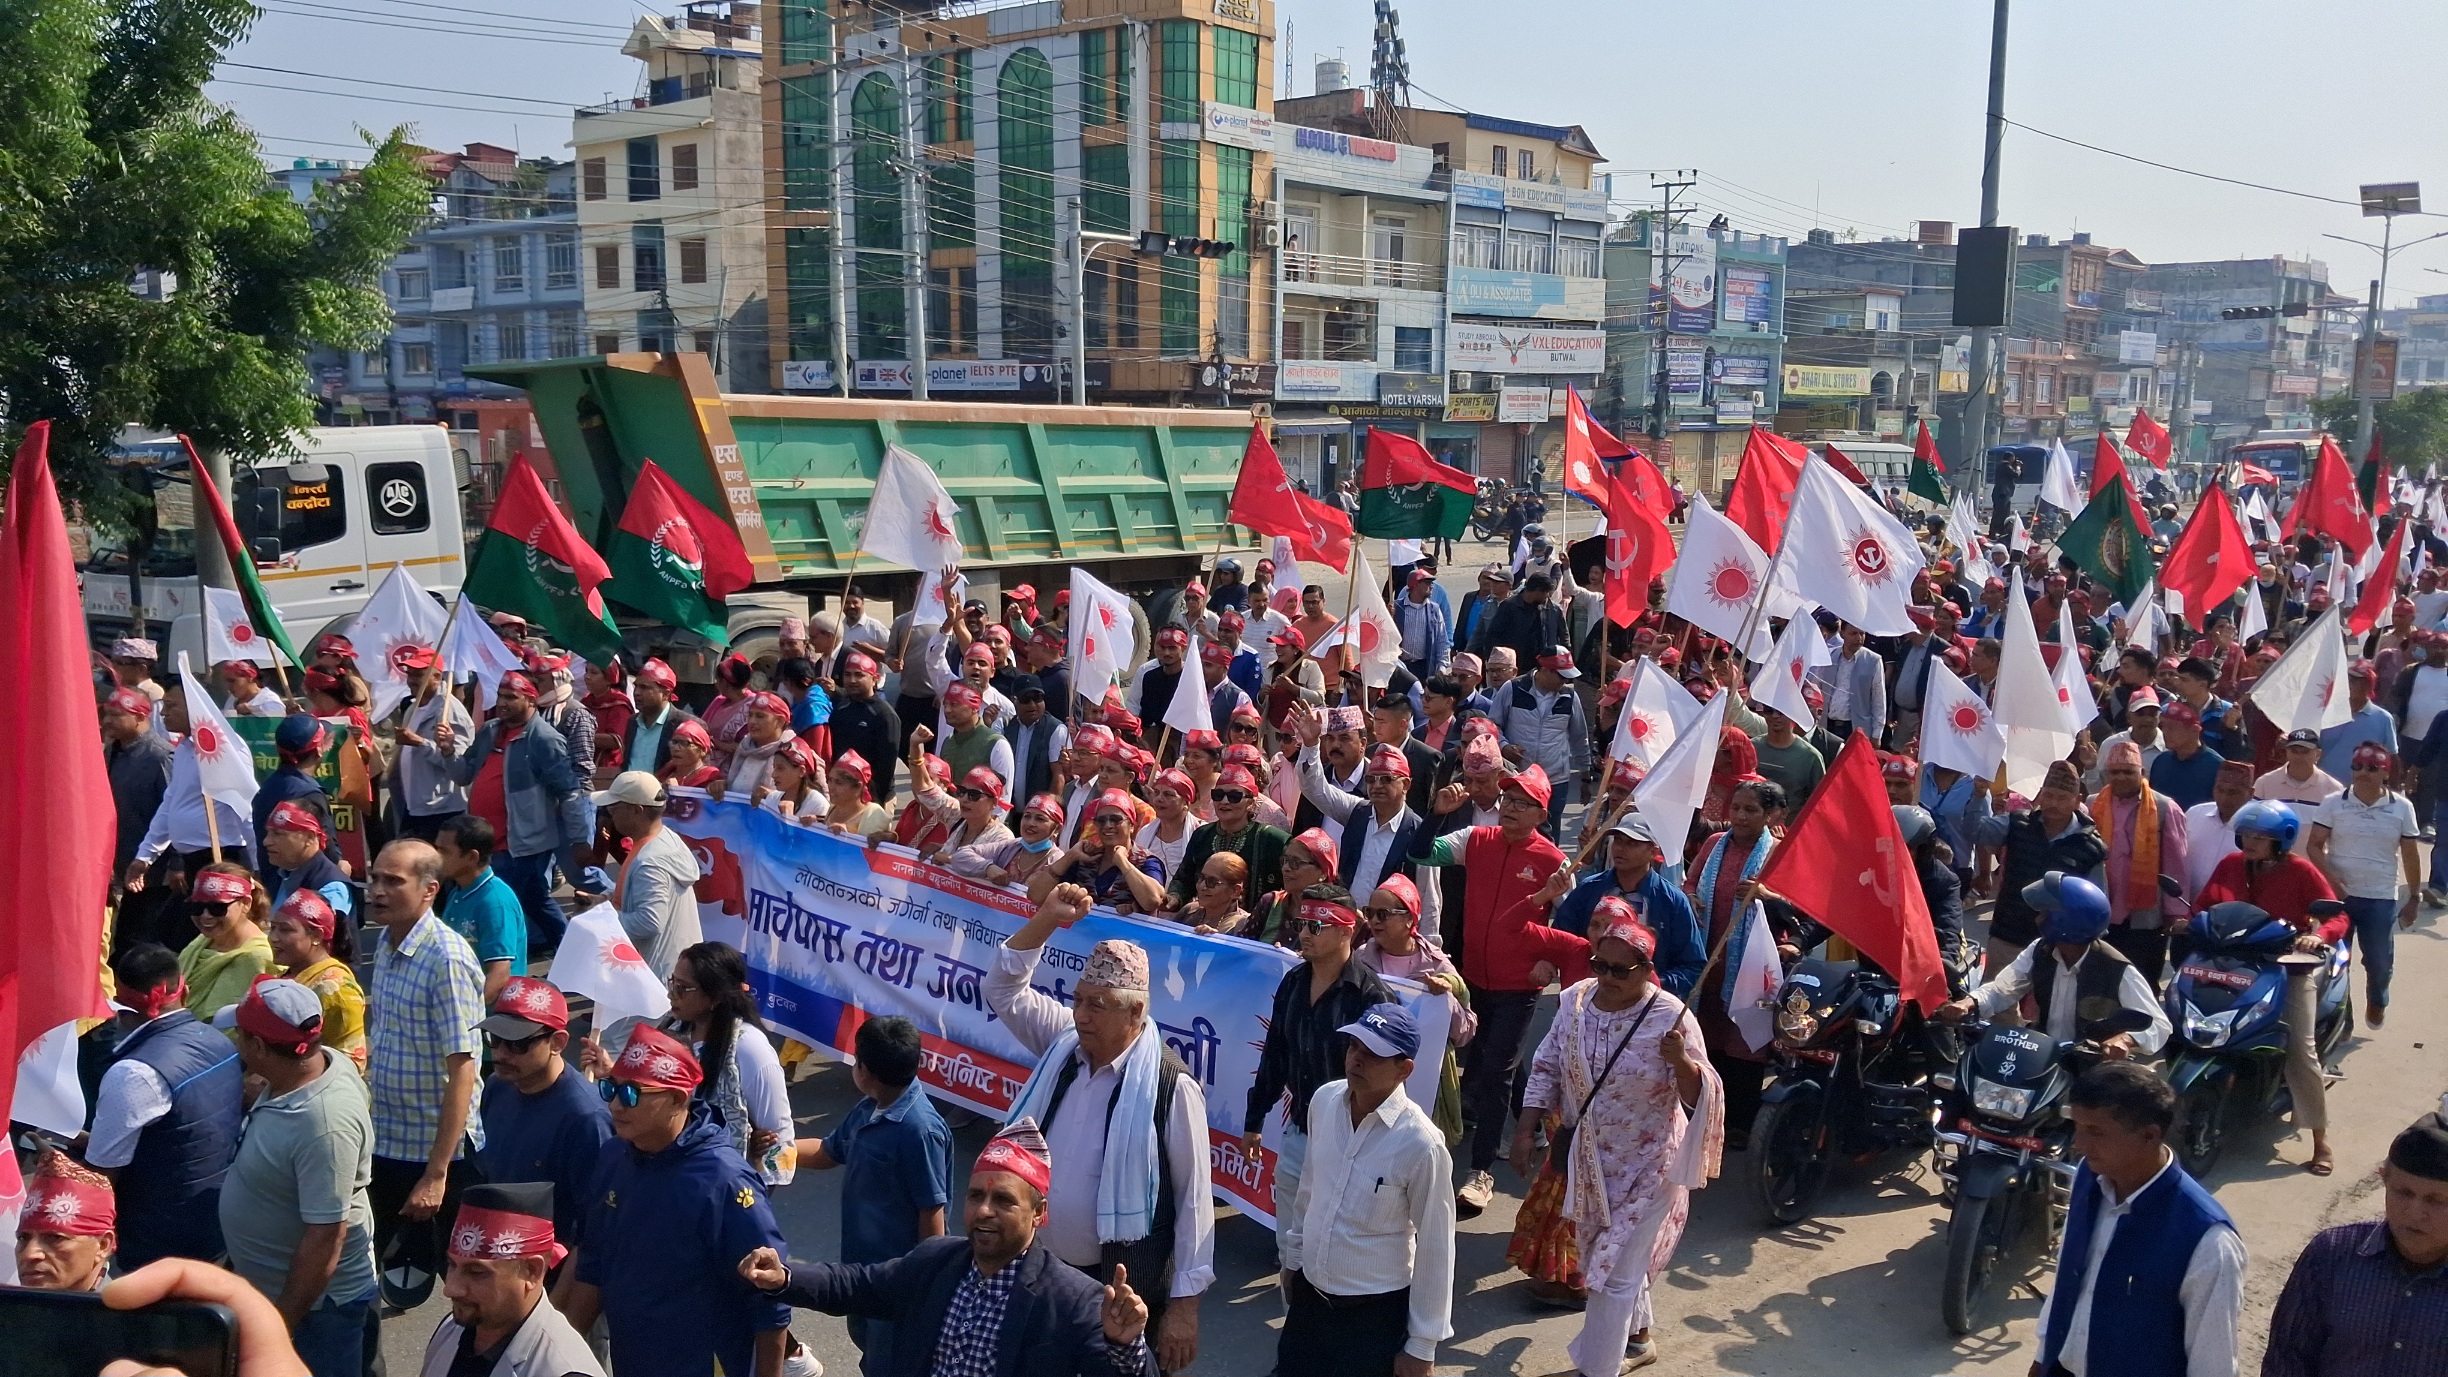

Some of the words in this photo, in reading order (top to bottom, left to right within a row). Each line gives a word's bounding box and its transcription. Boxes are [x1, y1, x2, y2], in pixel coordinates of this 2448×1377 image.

[1297, 127, 1337, 152] HOTEL
[1512, 187, 1526, 199] BON
[1527, 189, 1563, 204] EDUCATION
[1675, 241, 1704, 254] NATIONS
[1491, 285, 1533, 303] ASSOCIATES
[1458, 331, 1475, 340] STUDY
[1476, 333, 1497, 342] ABROAD
[1531, 336, 1549, 349] VXL
[1551, 337, 1602, 350] EDUCATION
[1550, 352, 1576, 362] BUTWAL
[927, 367, 967, 384] -planet
[970, 365, 995, 377] IELTS
[999, 365, 1017, 377] PTE
[1822, 373, 1832, 388] OIL
[1833, 374, 1857, 389] STORES
[1382, 394, 1407, 405] HOTEL
[1412, 394, 1442, 405] YARSHA
[1455, 397, 1481, 406] SPORTS
[1483, 396, 1495, 406] HUB
[725, 470, 743, 482] एण्ड
[794, 864, 881, 911] लोकतन्त्रको
[933, 909, 958, 933] तथा
[853, 930, 925, 990] तथा
[1366, 1013, 1388, 1029] UFC
[1994, 1034, 2040, 1052] BROTHER
